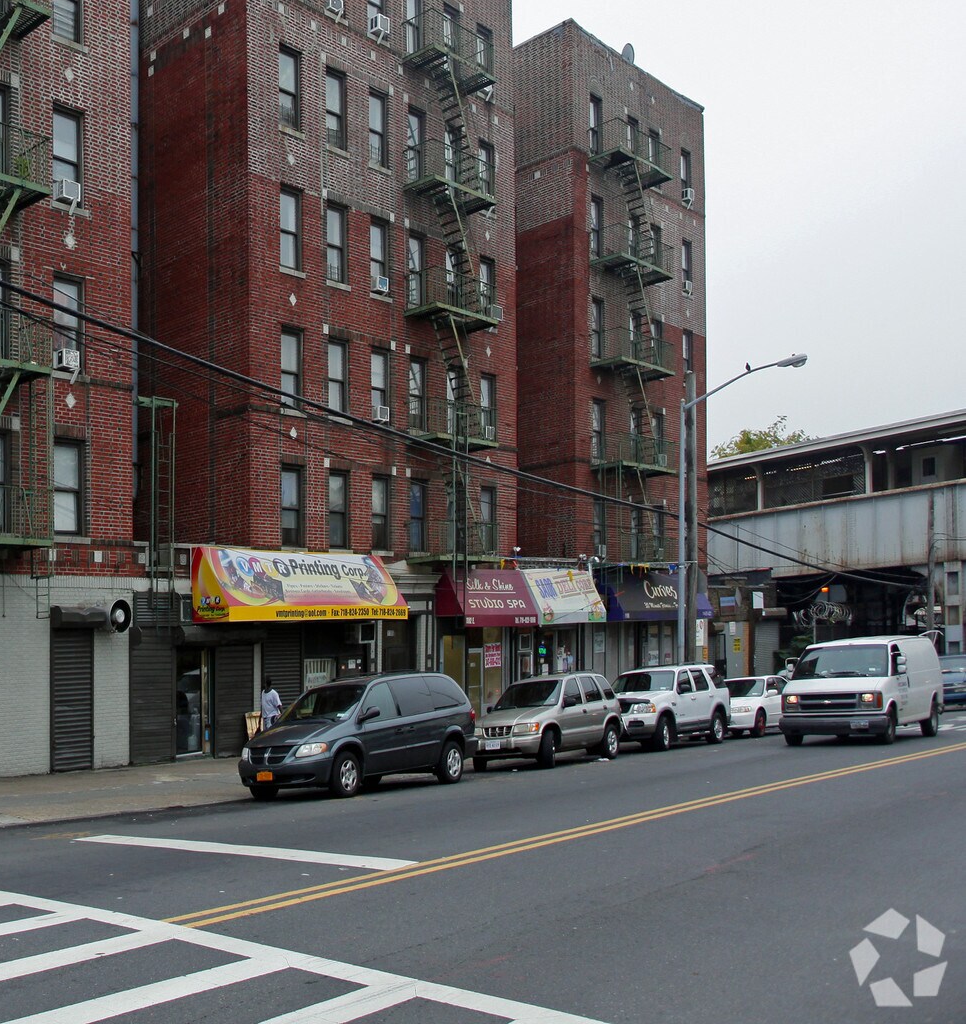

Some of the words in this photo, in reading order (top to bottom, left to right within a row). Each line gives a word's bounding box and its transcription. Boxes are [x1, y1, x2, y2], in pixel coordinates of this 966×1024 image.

[288, 558, 341, 580] Printing
[466, 578, 484, 591] Silk
[484, 582, 491, 591] &
[492, 578, 514, 591] Shine
[644, 580, 678, 599] Curves
[468, 597, 504, 609] STUDIO
[507, 599, 526, 609] SPA
